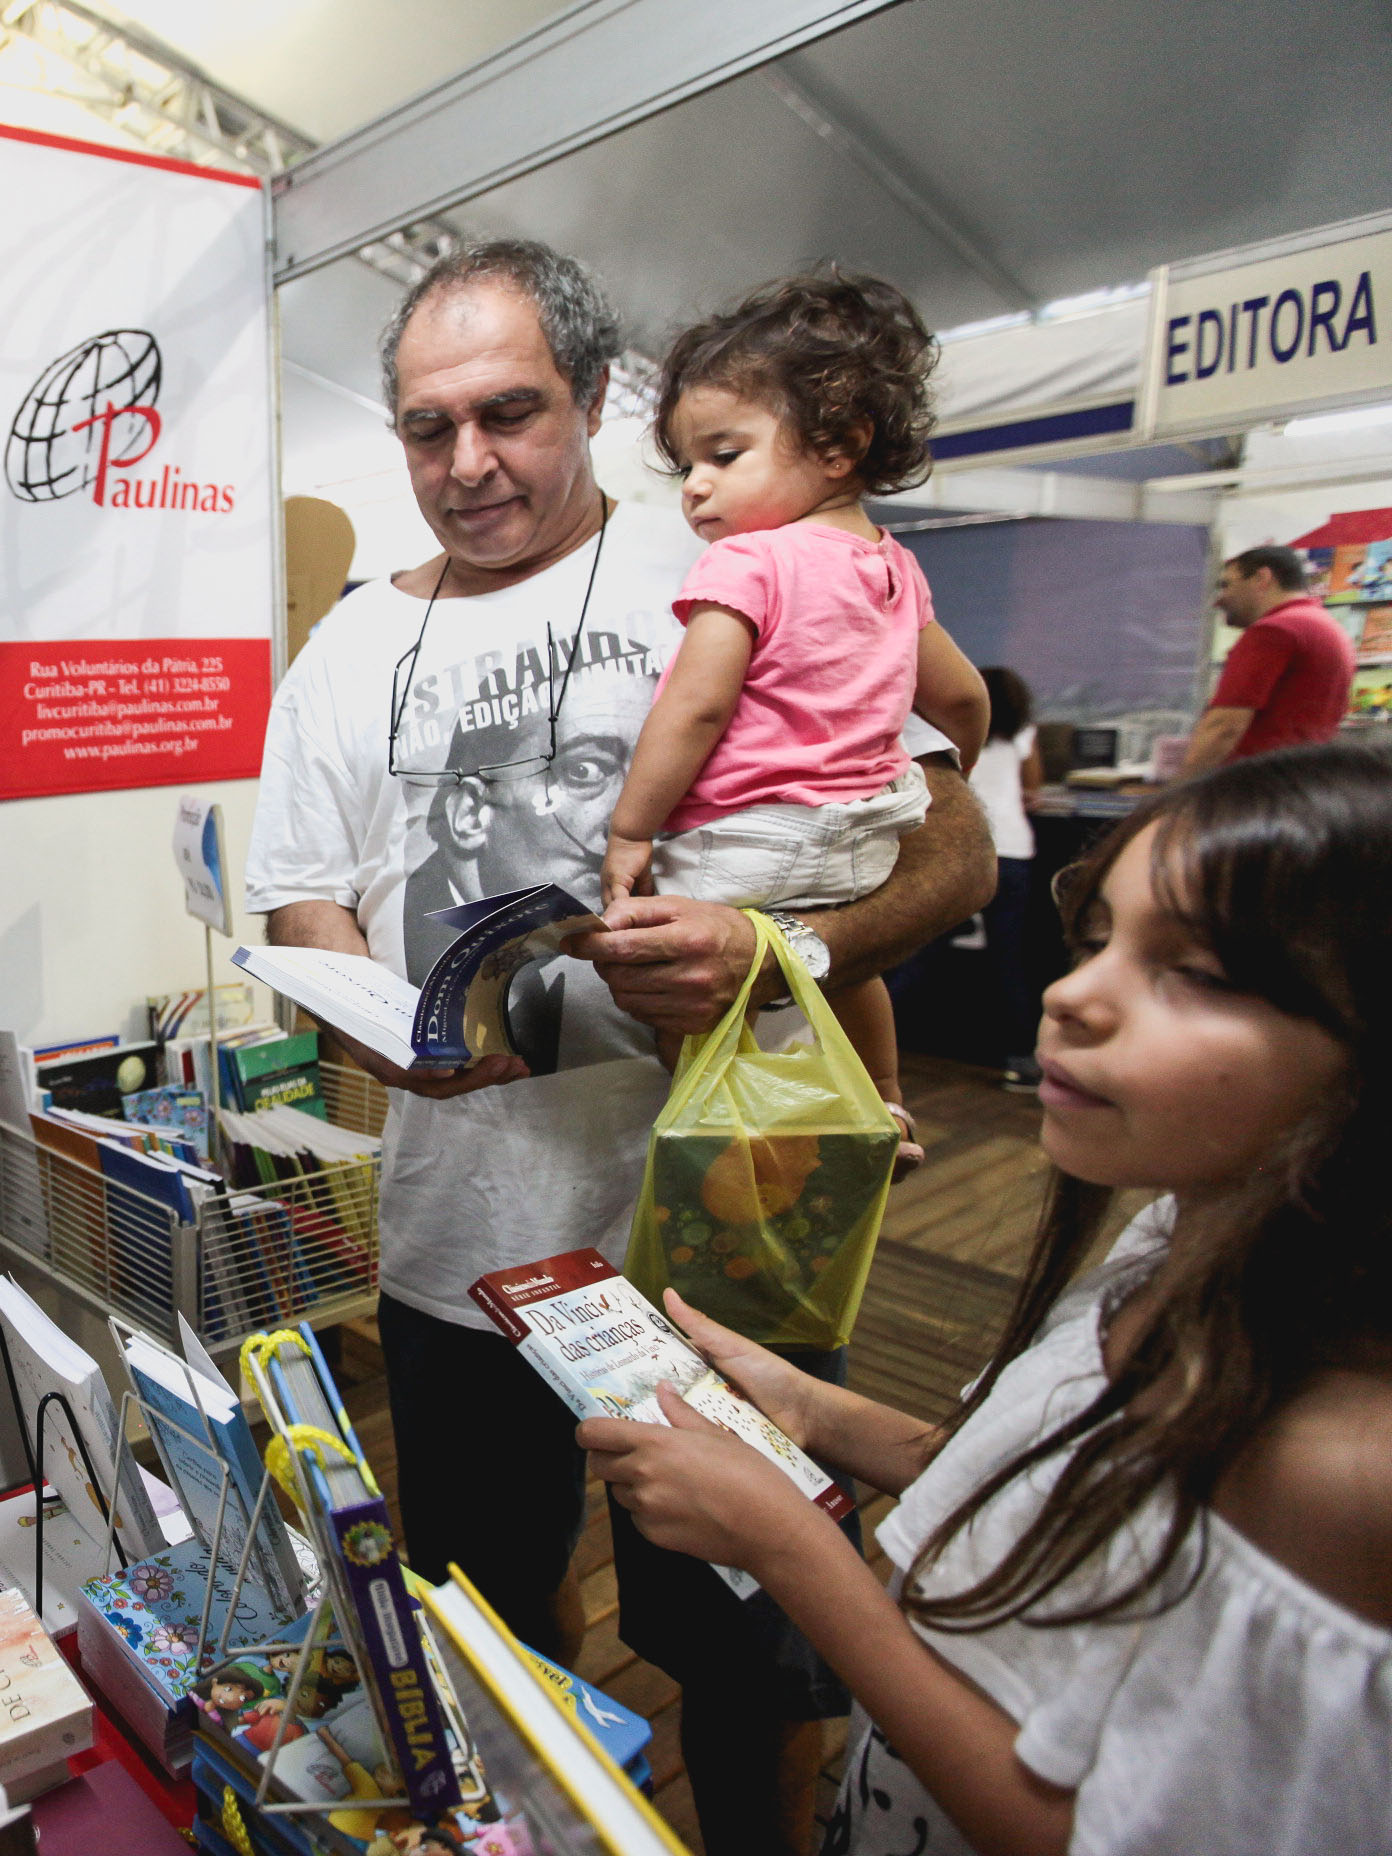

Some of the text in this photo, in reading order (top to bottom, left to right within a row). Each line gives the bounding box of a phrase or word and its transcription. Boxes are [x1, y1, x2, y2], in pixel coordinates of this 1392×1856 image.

[1165, 269, 1377, 388] EDITORA
[71, 399, 236, 514] Paulinas
[29, 661, 58, 678] Rua
[60, 659, 140, 677] Voluntários
[141, 657, 160, 675] da
[23, 680, 106, 700] Curitiba-PR
[117, 678, 140, 696] Tel.
[143, 678, 171, 696] (41)
[21, 715, 233, 748] promocuritiba@paulinas.com.br
[63, 736, 199, 760] www.paulinas.org.br
[426, 902, 551, 1044] Dom Quixote
[526, 1295, 605, 1337] Da Vinci
[553, 1317, 646, 1363] das crianças
[1, 1692, 32, 1723] DE
